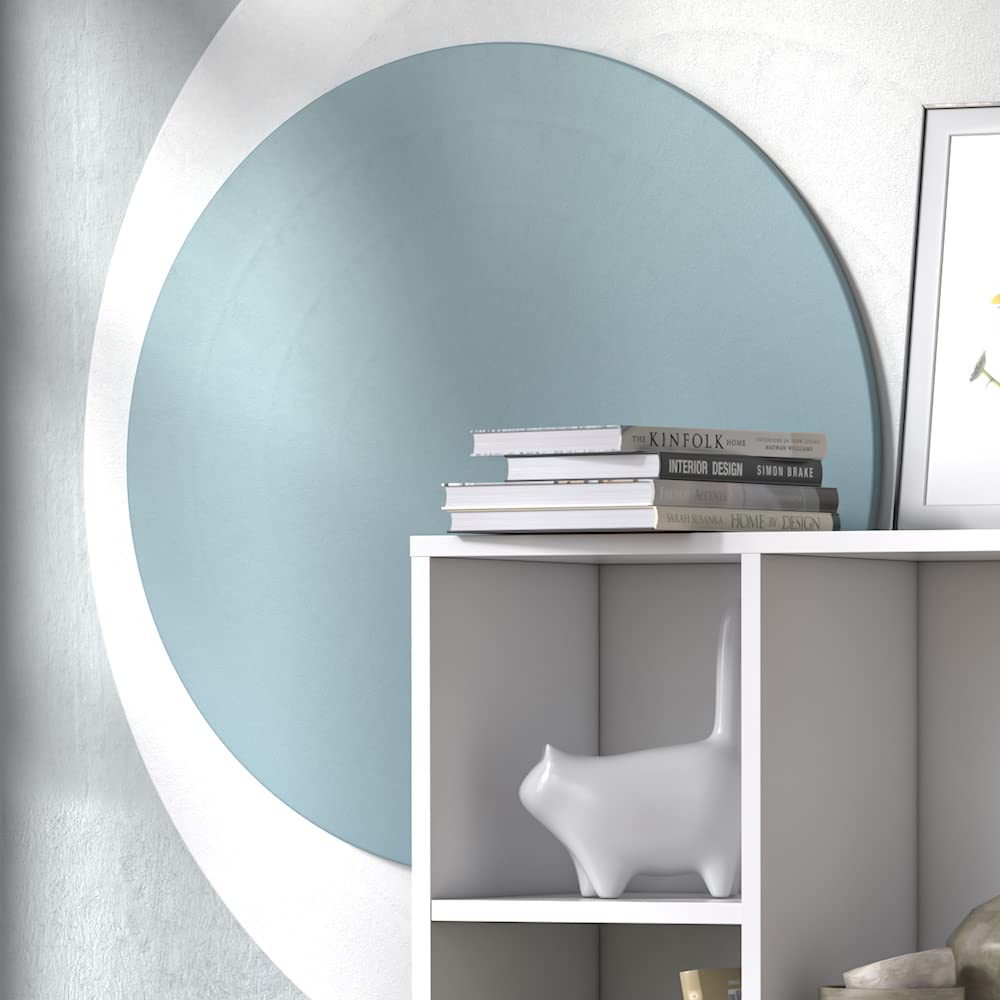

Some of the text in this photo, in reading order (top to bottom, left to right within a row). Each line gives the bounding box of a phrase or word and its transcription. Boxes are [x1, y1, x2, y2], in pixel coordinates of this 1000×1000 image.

[632, 435, 646, 443] THE
[649, 432, 725, 450] KINFOLK
[726, 439, 746, 448] HOME
[668, 459, 814, 478] INTERIOR DESIGN SIMON BRAKE
[730, 513, 764, 529] HOME
[782, 516, 821, 530] DESIGN
